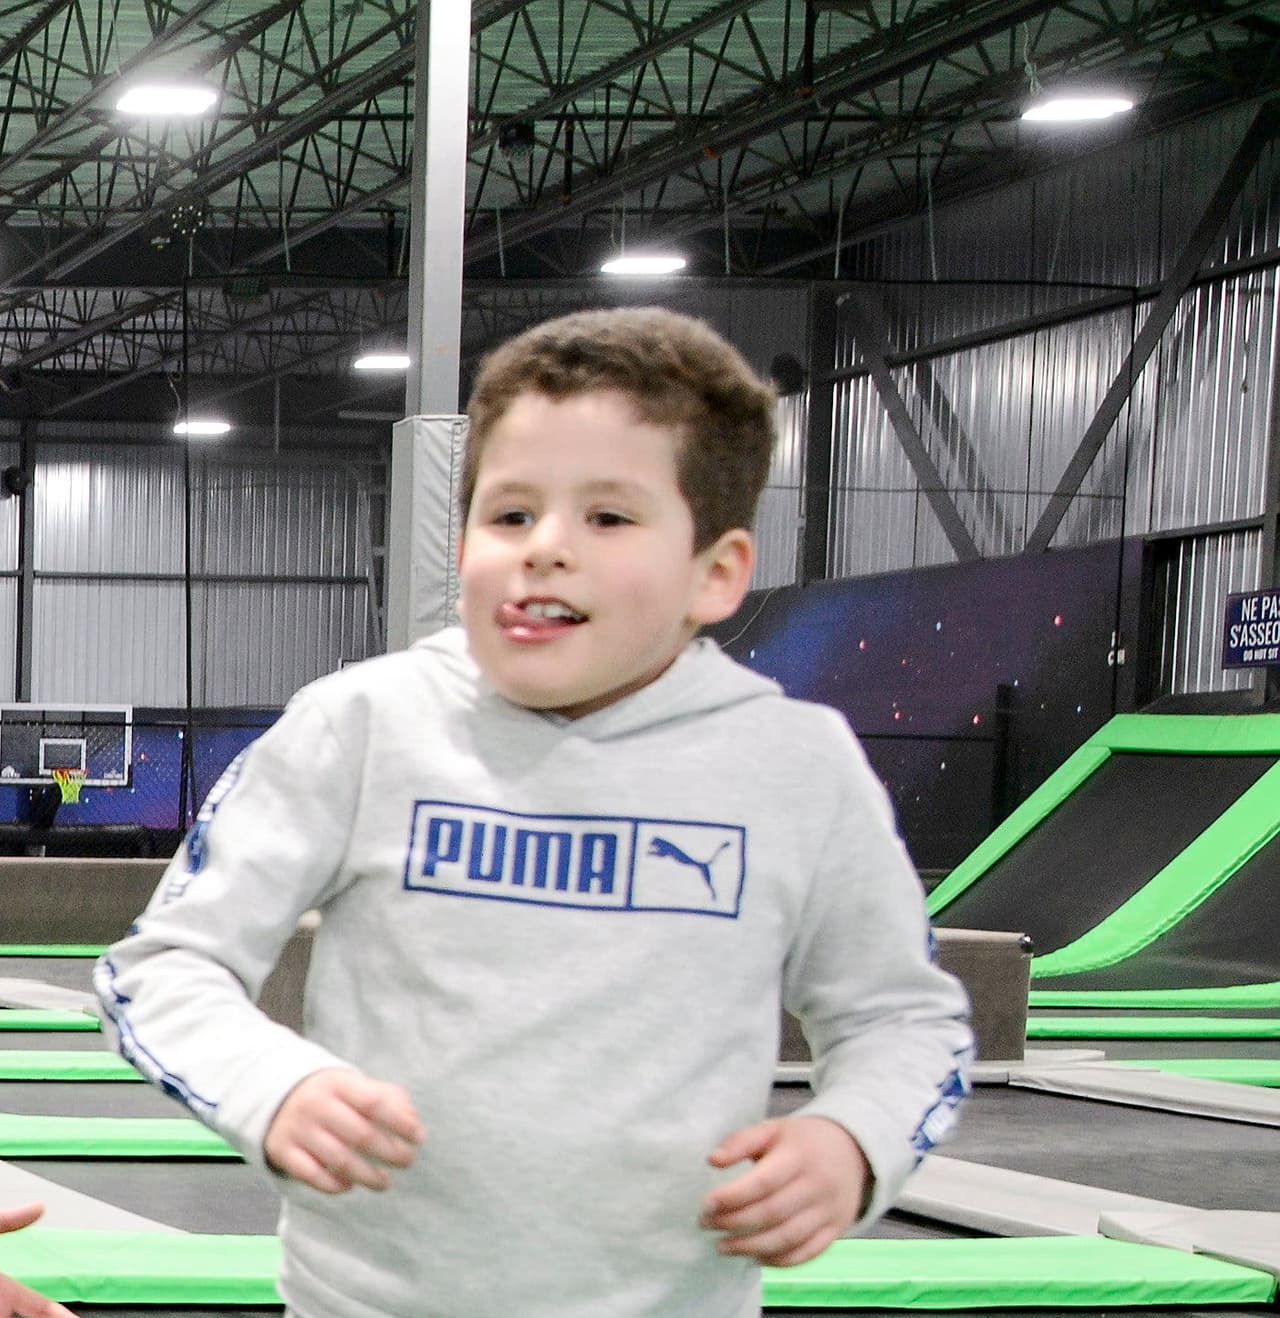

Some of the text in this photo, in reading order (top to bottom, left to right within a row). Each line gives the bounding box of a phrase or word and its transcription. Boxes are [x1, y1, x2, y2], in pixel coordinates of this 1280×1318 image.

[1241, 595, 1280, 621] NE PA
[1268, 647, 1279, 660] SIT
[422, 817, 617, 894] PUMA
